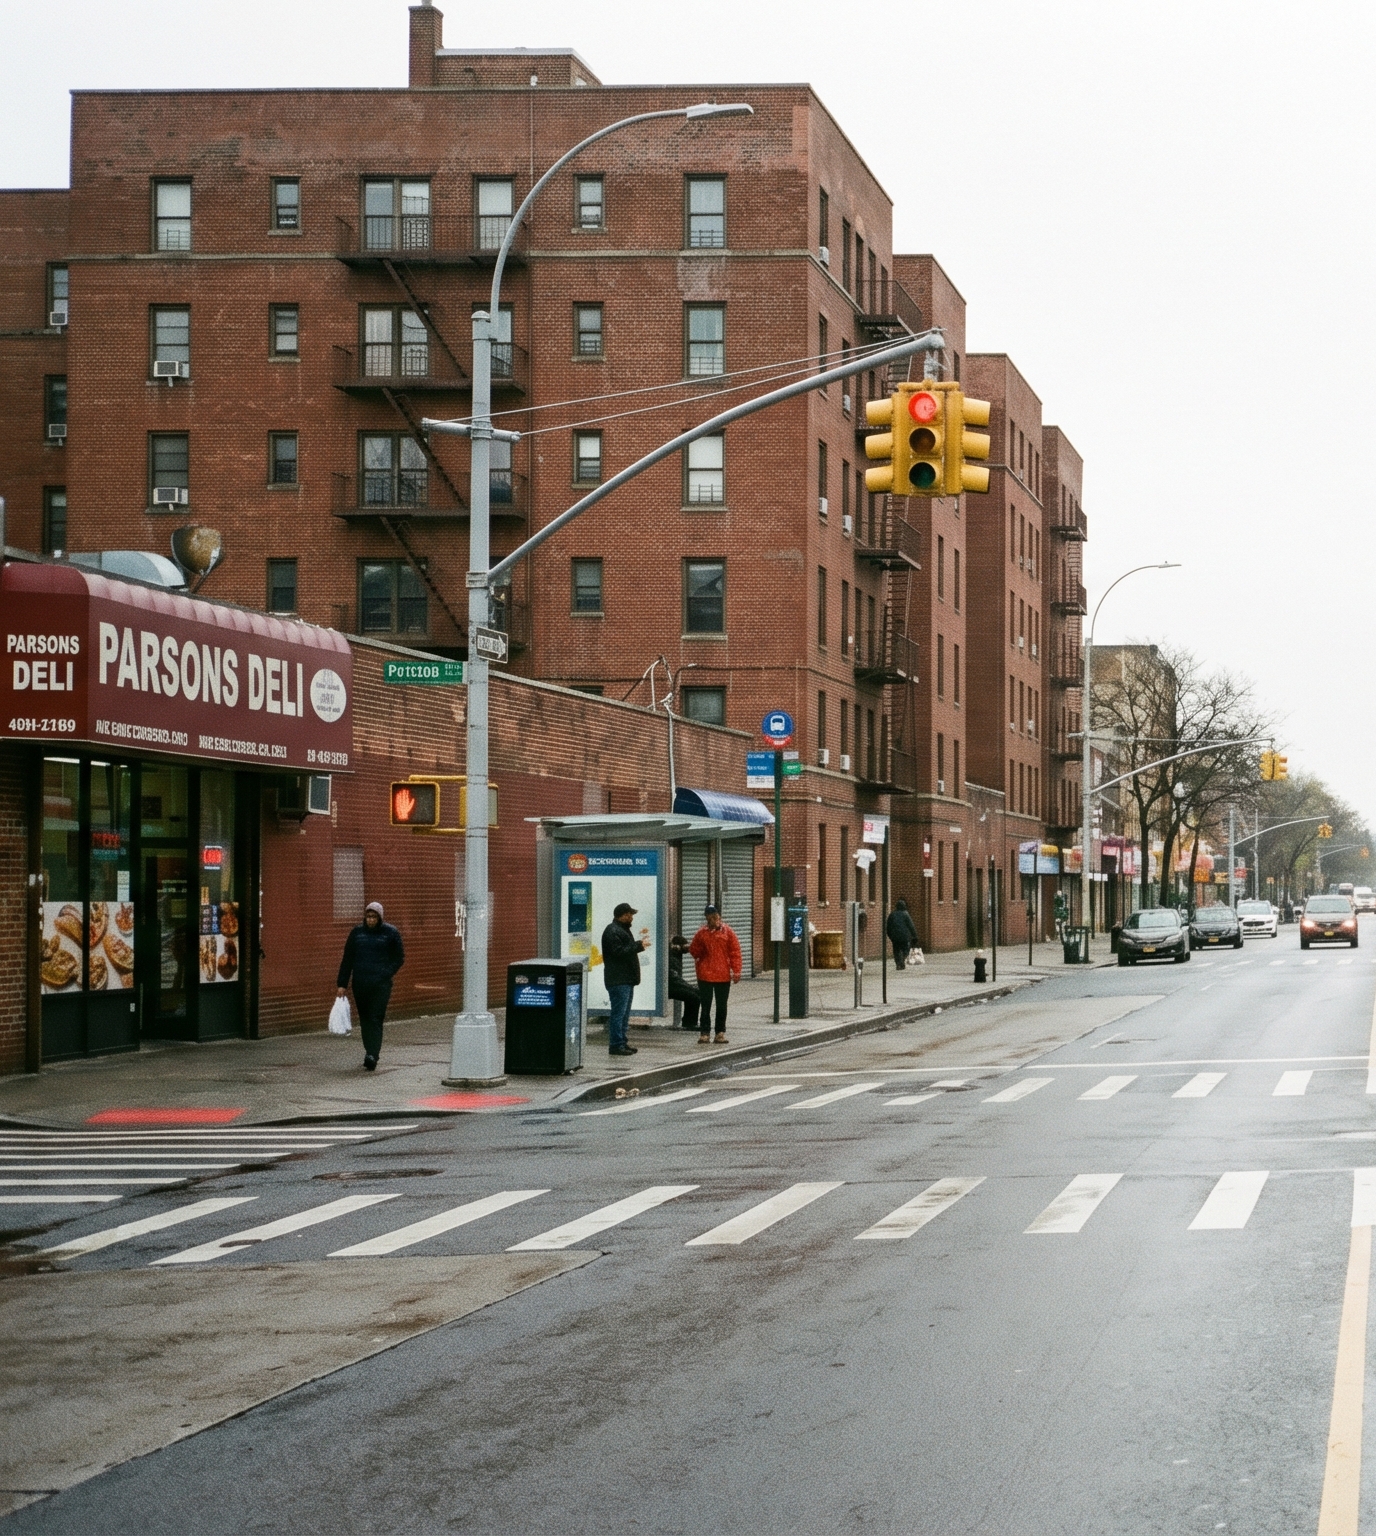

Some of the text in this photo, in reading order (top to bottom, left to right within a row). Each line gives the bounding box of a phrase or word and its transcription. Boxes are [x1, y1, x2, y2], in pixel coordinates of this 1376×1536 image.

[7, 634, 80, 655] PARSONS
[13, 660, 74, 691] DELI
[99, 621, 239, 708] PARSONS
[248, 653, 304, 718] DELI
